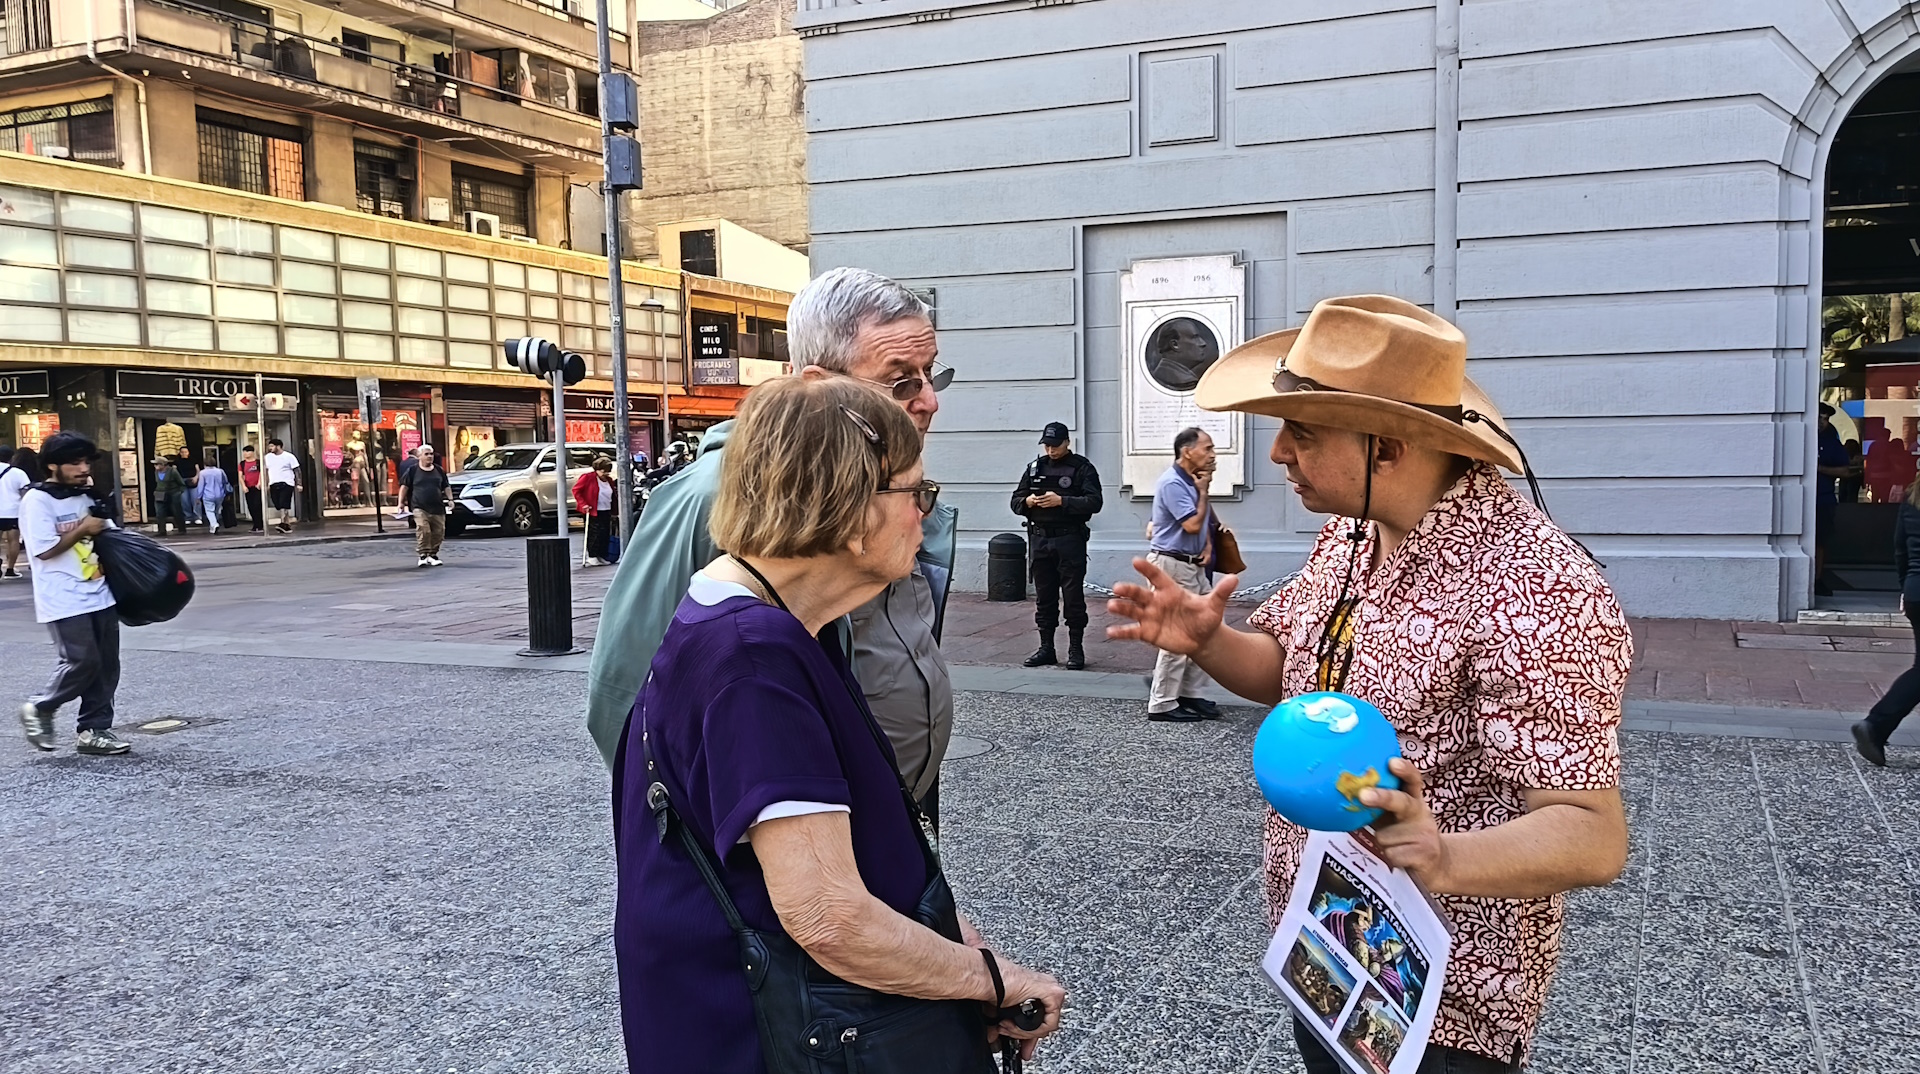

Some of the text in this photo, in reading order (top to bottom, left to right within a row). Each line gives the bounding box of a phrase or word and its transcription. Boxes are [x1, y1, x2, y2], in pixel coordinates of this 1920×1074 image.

[1151, 276, 1169, 284] 1896
[699, 325, 719, 333] CINES
[702, 336, 721, 344] NILO
[174, 377, 251, 397] TRICOT
[585, 397, 604, 409] MIS
[1325, 855, 1371, 899] HUASCAR
[1371, 894, 1384, 910] VS
[1382, 908, 1428, 970] ATAHUALPA
